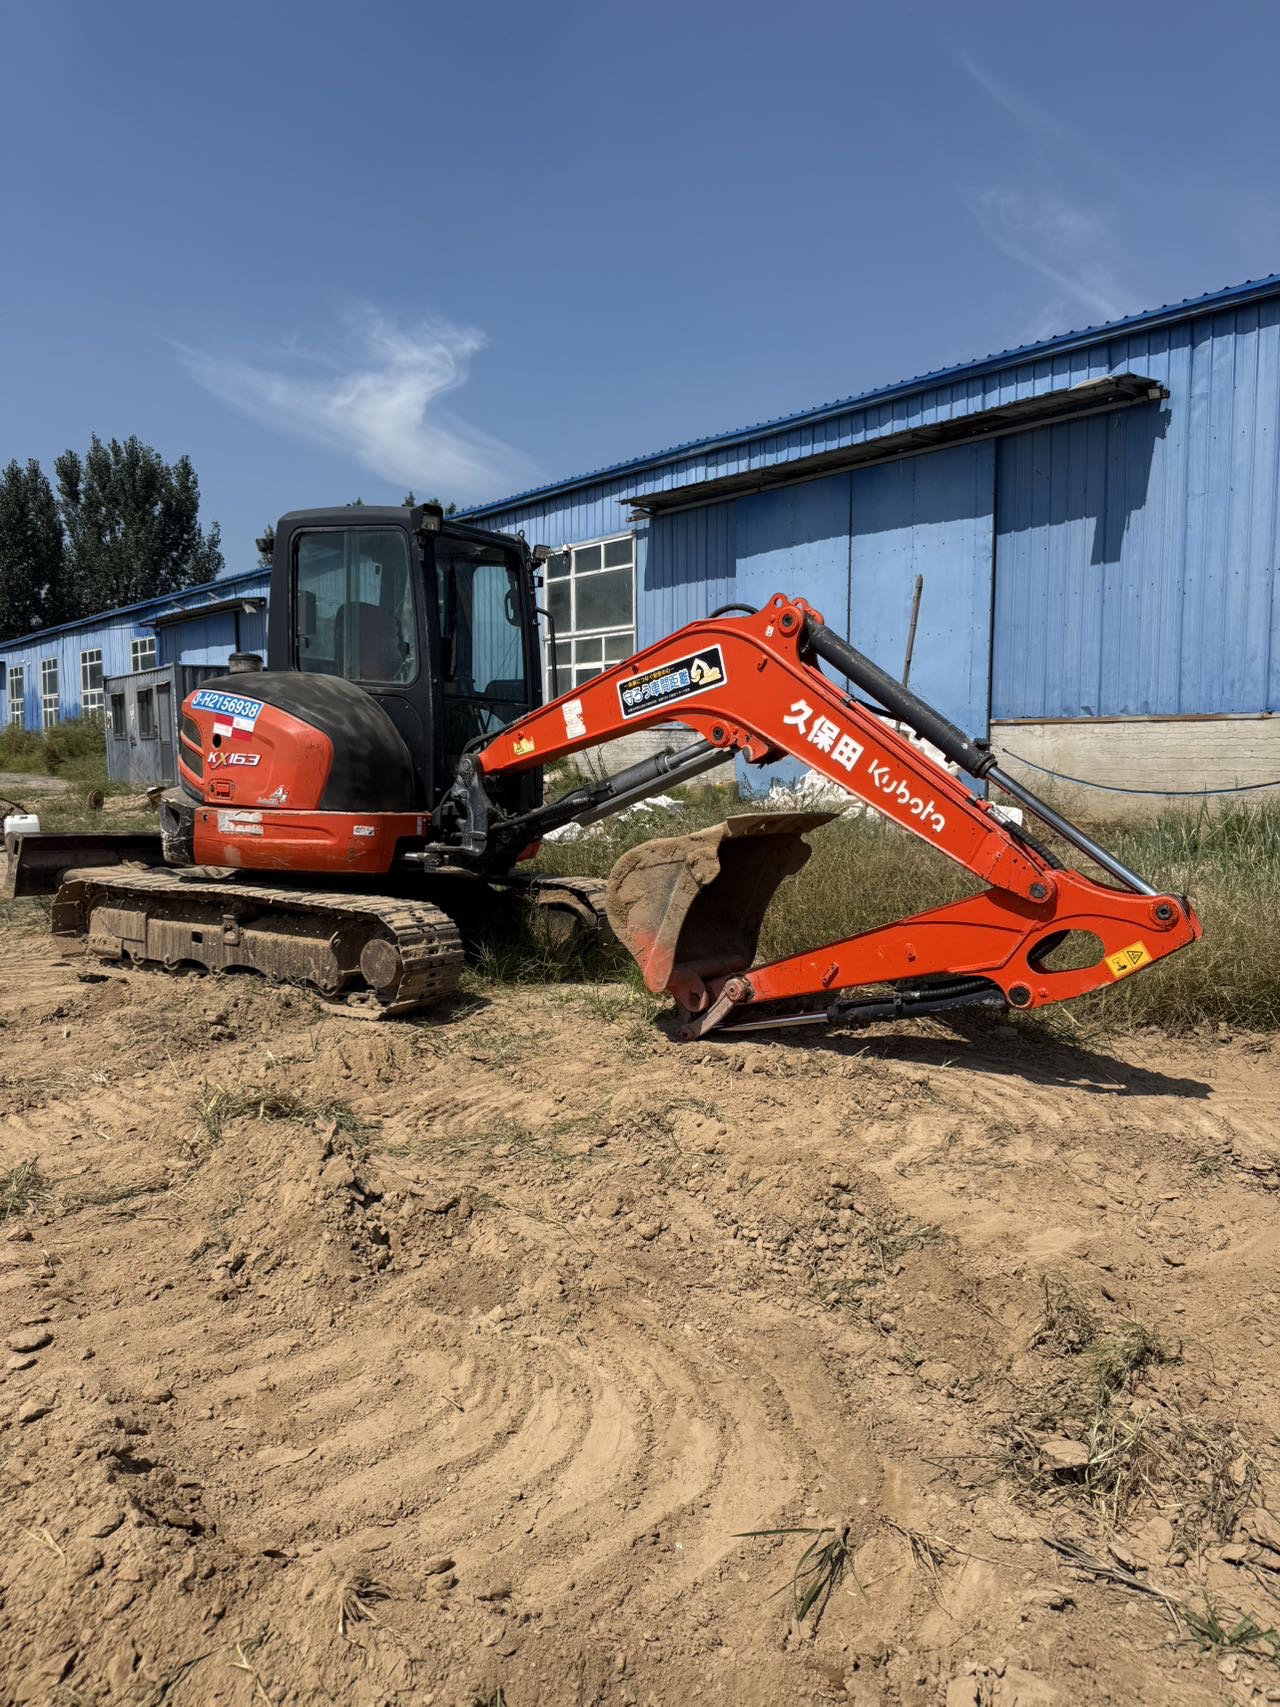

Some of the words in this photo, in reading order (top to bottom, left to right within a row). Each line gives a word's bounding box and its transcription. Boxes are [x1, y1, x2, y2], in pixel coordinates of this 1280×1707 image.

[193, 692, 259, 718] 3-H2156938
[783, 699, 865, 772] 久保田
[208, 752, 261, 769] KX163
[867, 758, 946, 833] Kubota
